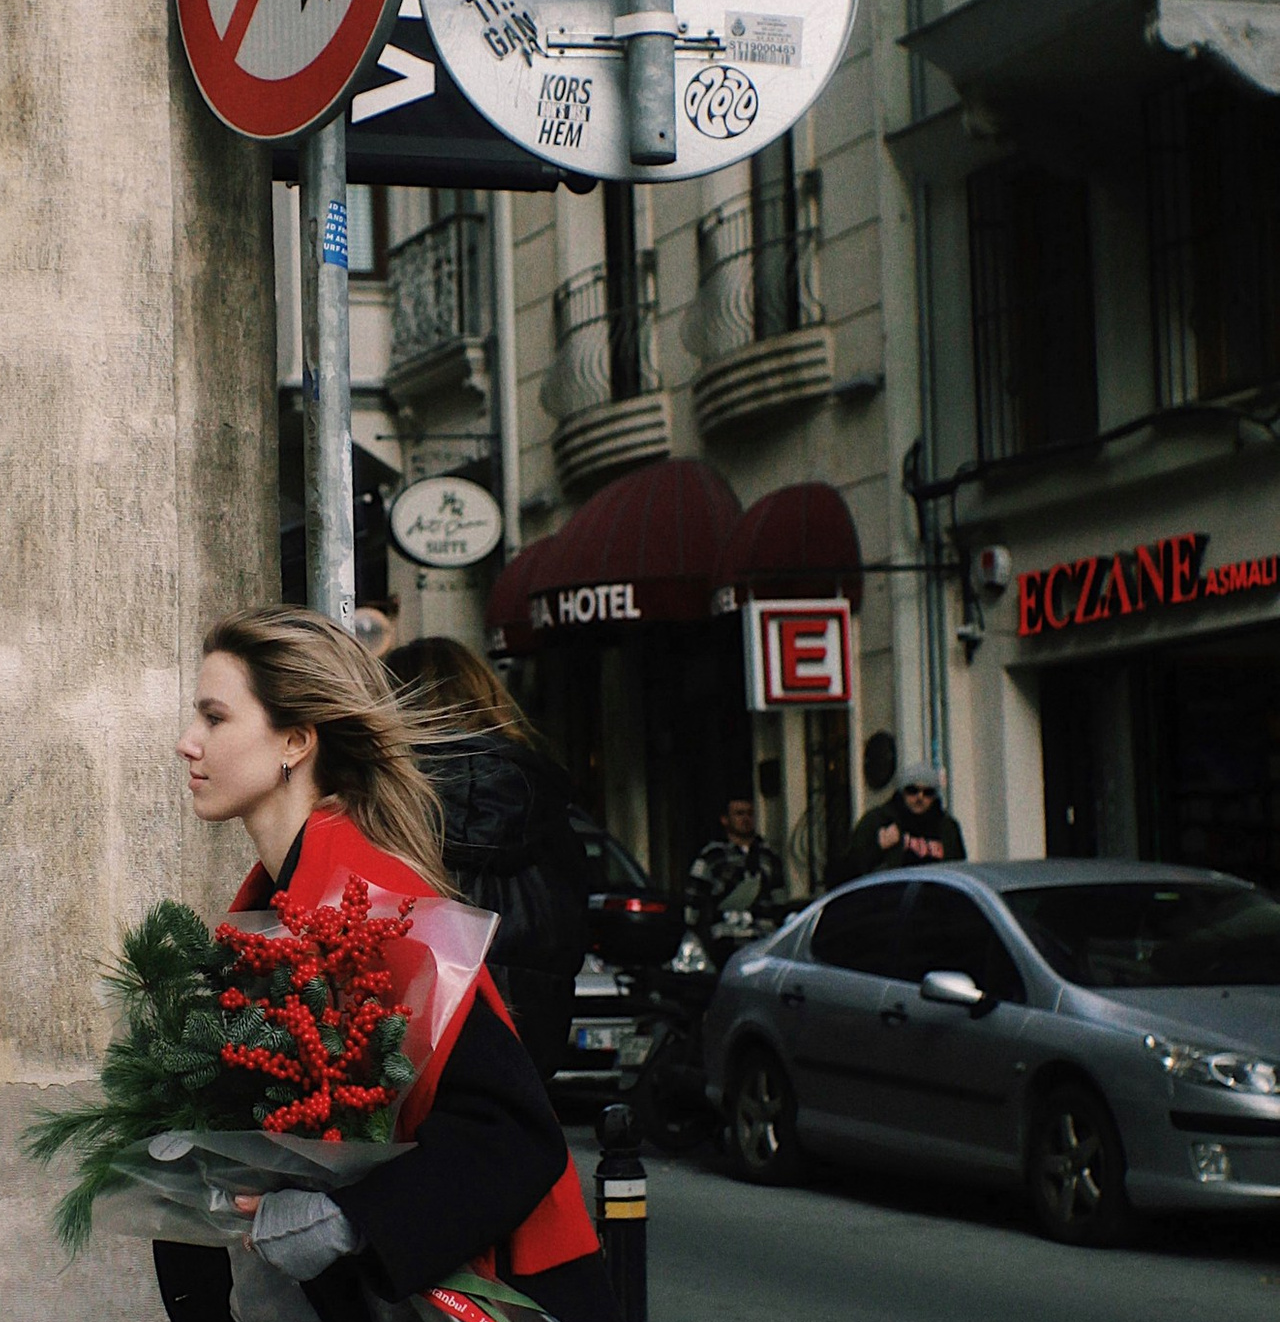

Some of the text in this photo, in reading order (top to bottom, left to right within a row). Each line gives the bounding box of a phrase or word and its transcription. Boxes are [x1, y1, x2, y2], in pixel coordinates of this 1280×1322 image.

[540, 74, 593, 104] KORS
[538, 119, 583, 148] HEM
[558, 582, 642, 624] HOTEL
[1018, 532, 1199, 636] ECZANE
[781, 620, 831, 690] E
